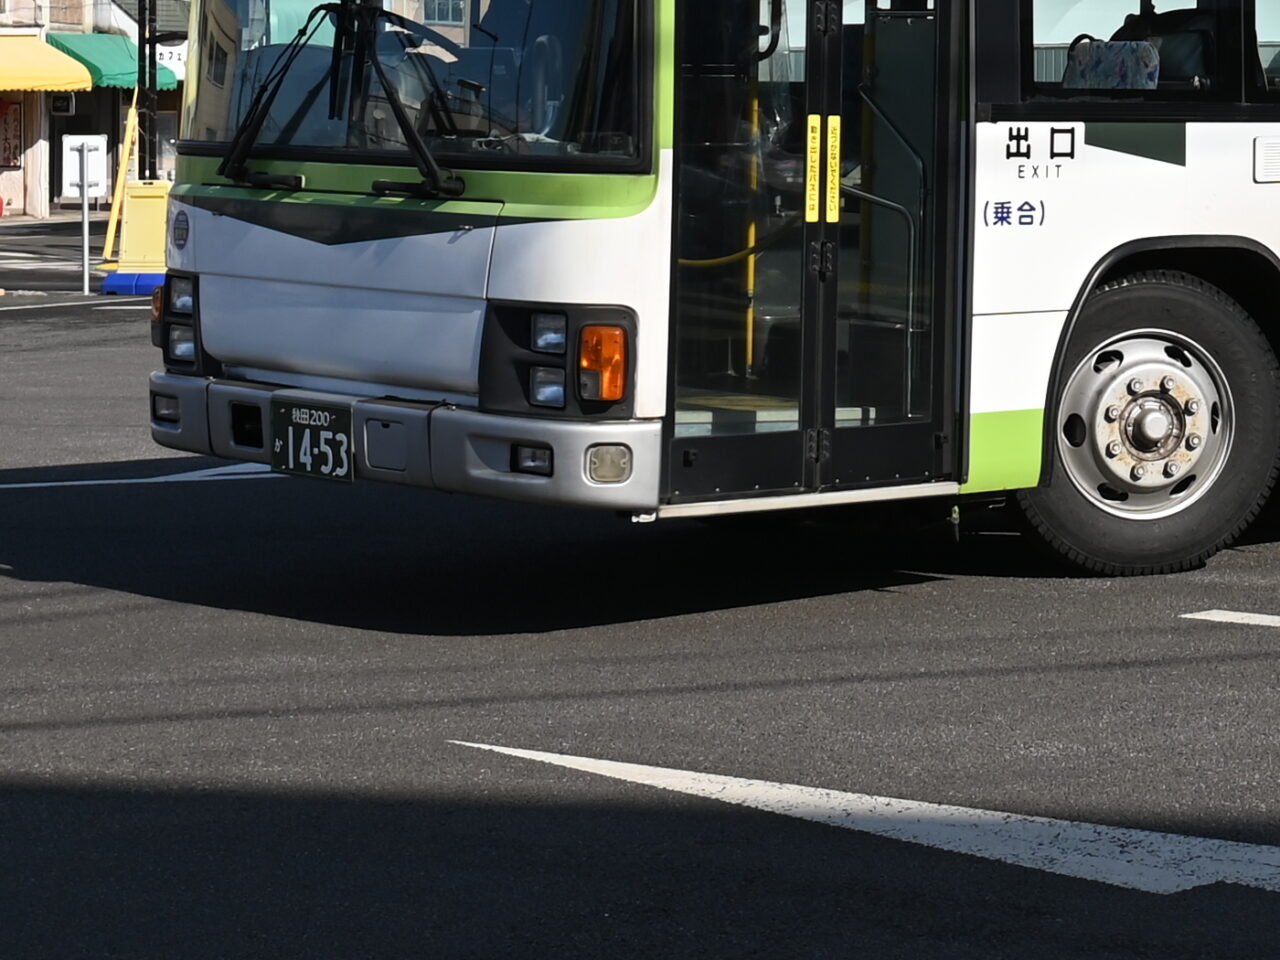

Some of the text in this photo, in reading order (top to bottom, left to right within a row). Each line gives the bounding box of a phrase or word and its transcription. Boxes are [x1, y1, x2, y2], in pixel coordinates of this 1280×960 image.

[158, 51, 182, 62] カフェ
[1005, 126, 1076, 160] 出口
[1017, 164, 1063, 179] EXIT
[983, 199, 1045, 227] (乗合)
